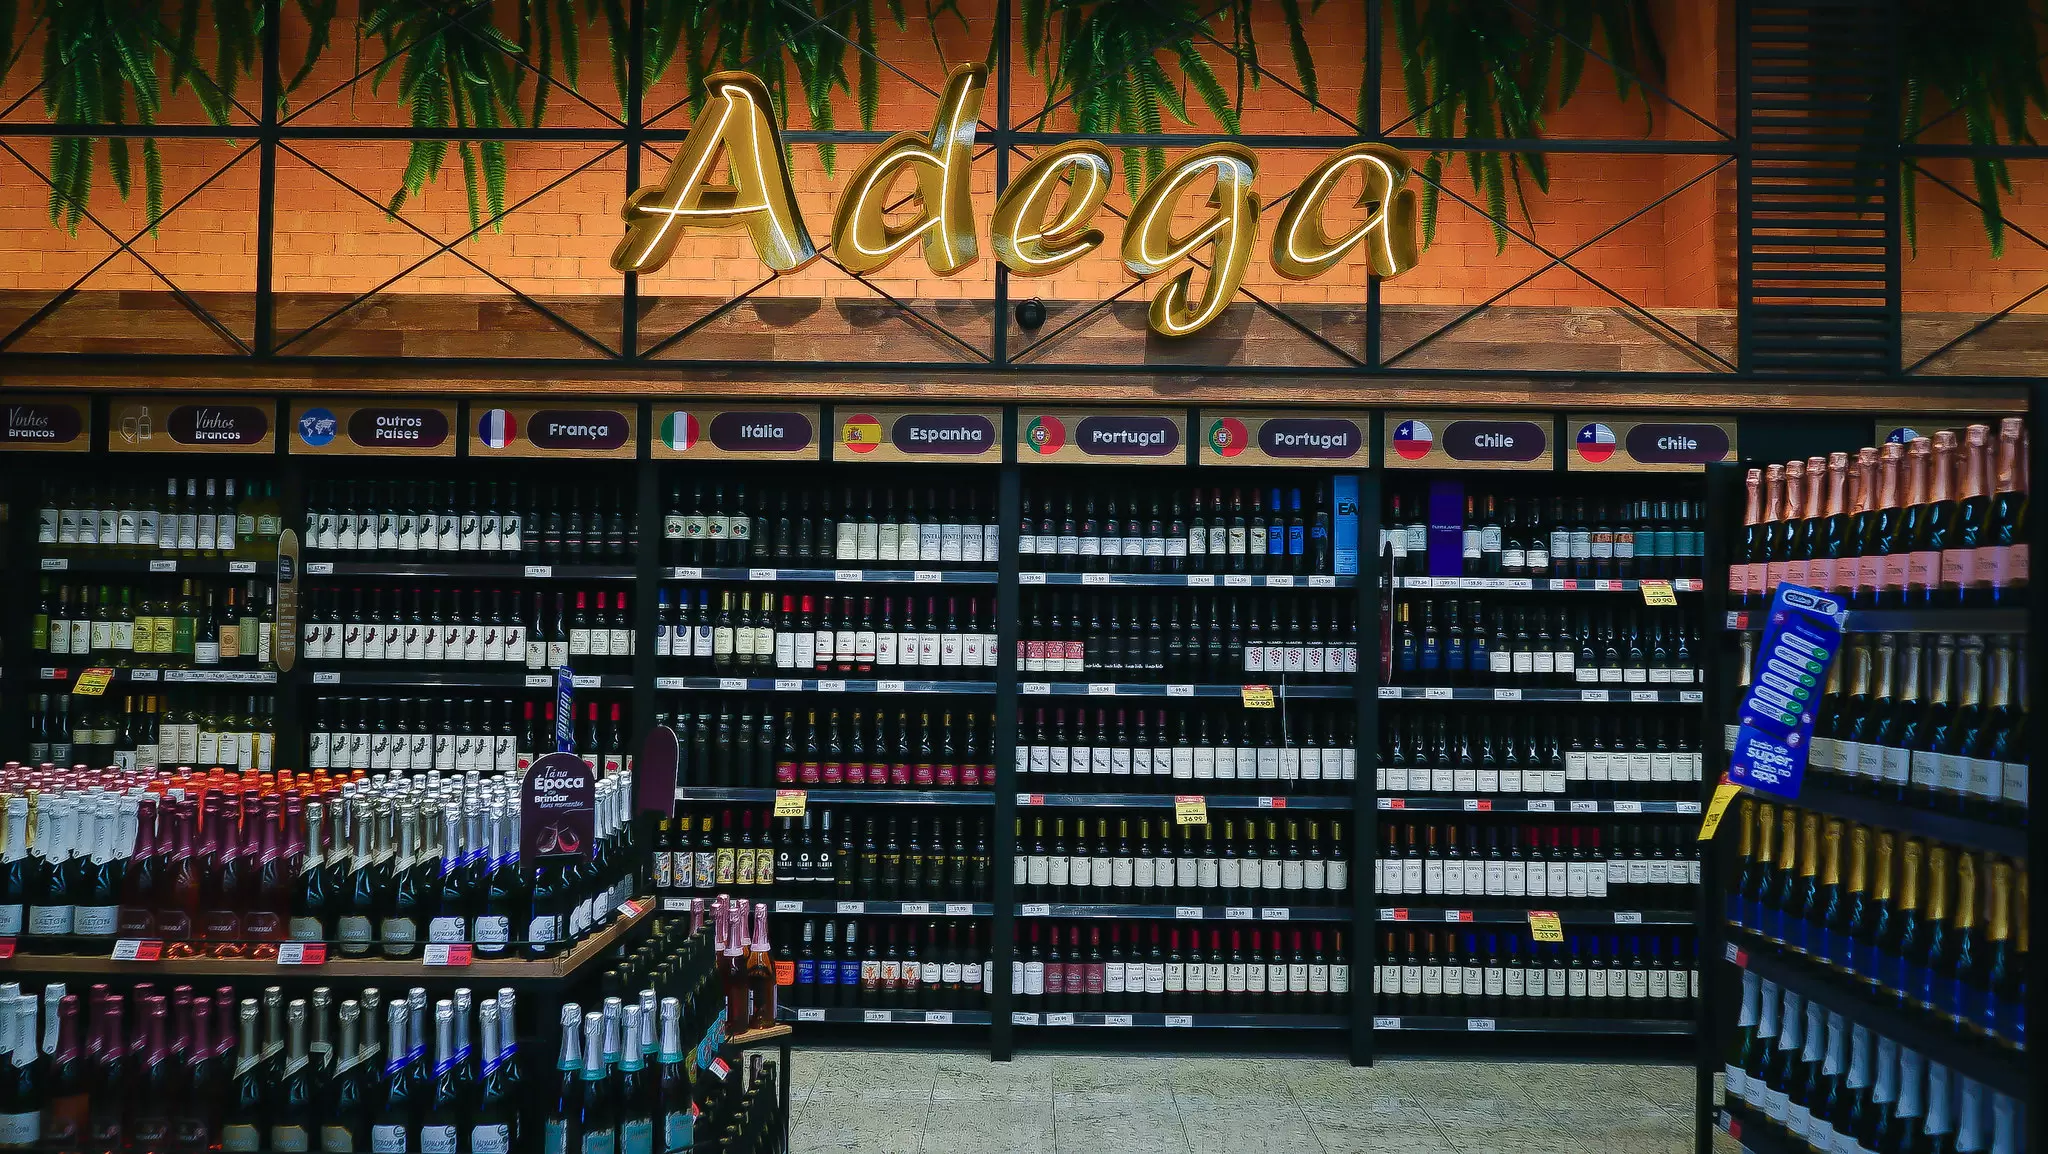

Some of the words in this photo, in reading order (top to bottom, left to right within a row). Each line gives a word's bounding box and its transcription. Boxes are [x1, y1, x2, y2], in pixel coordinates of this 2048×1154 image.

[611, 62, 1417, 338] Adega
[9, 407, 48, 428] Vinhos
[195, 408, 235, 429] Vinhos
[376, 416, 422, 427] Outros
[9, 429, 55, 438] Brancos
[195, 430, 241, 440] Brancos
[375, 427, 419, 439] Países
[549, 423, 609, 440] França
[741, 424, 784, 439] Itália
[910, 427, 982, 443] Espanha
[1092, 429, 1166, 447] Portugal
[1275, 432, 1348, 449] Portugal
[1474, 433, 1514, 448] Chile
[1657, 436, 1698, 451] Chile
[1750, 738, 1773, 751] tudo
[1774, 746, 1788, 755] de
[1746, 747, 1793, 770] super,
[545, 765, 556, 778] Tá
[1751, 769, 1780, 784] app.
[1753, 761, 1777, 773] tudo
[1778, 768, 1791, 777] no
[534, 774, 584, 792] Época
[534, 794, 569, 803] Brindar
